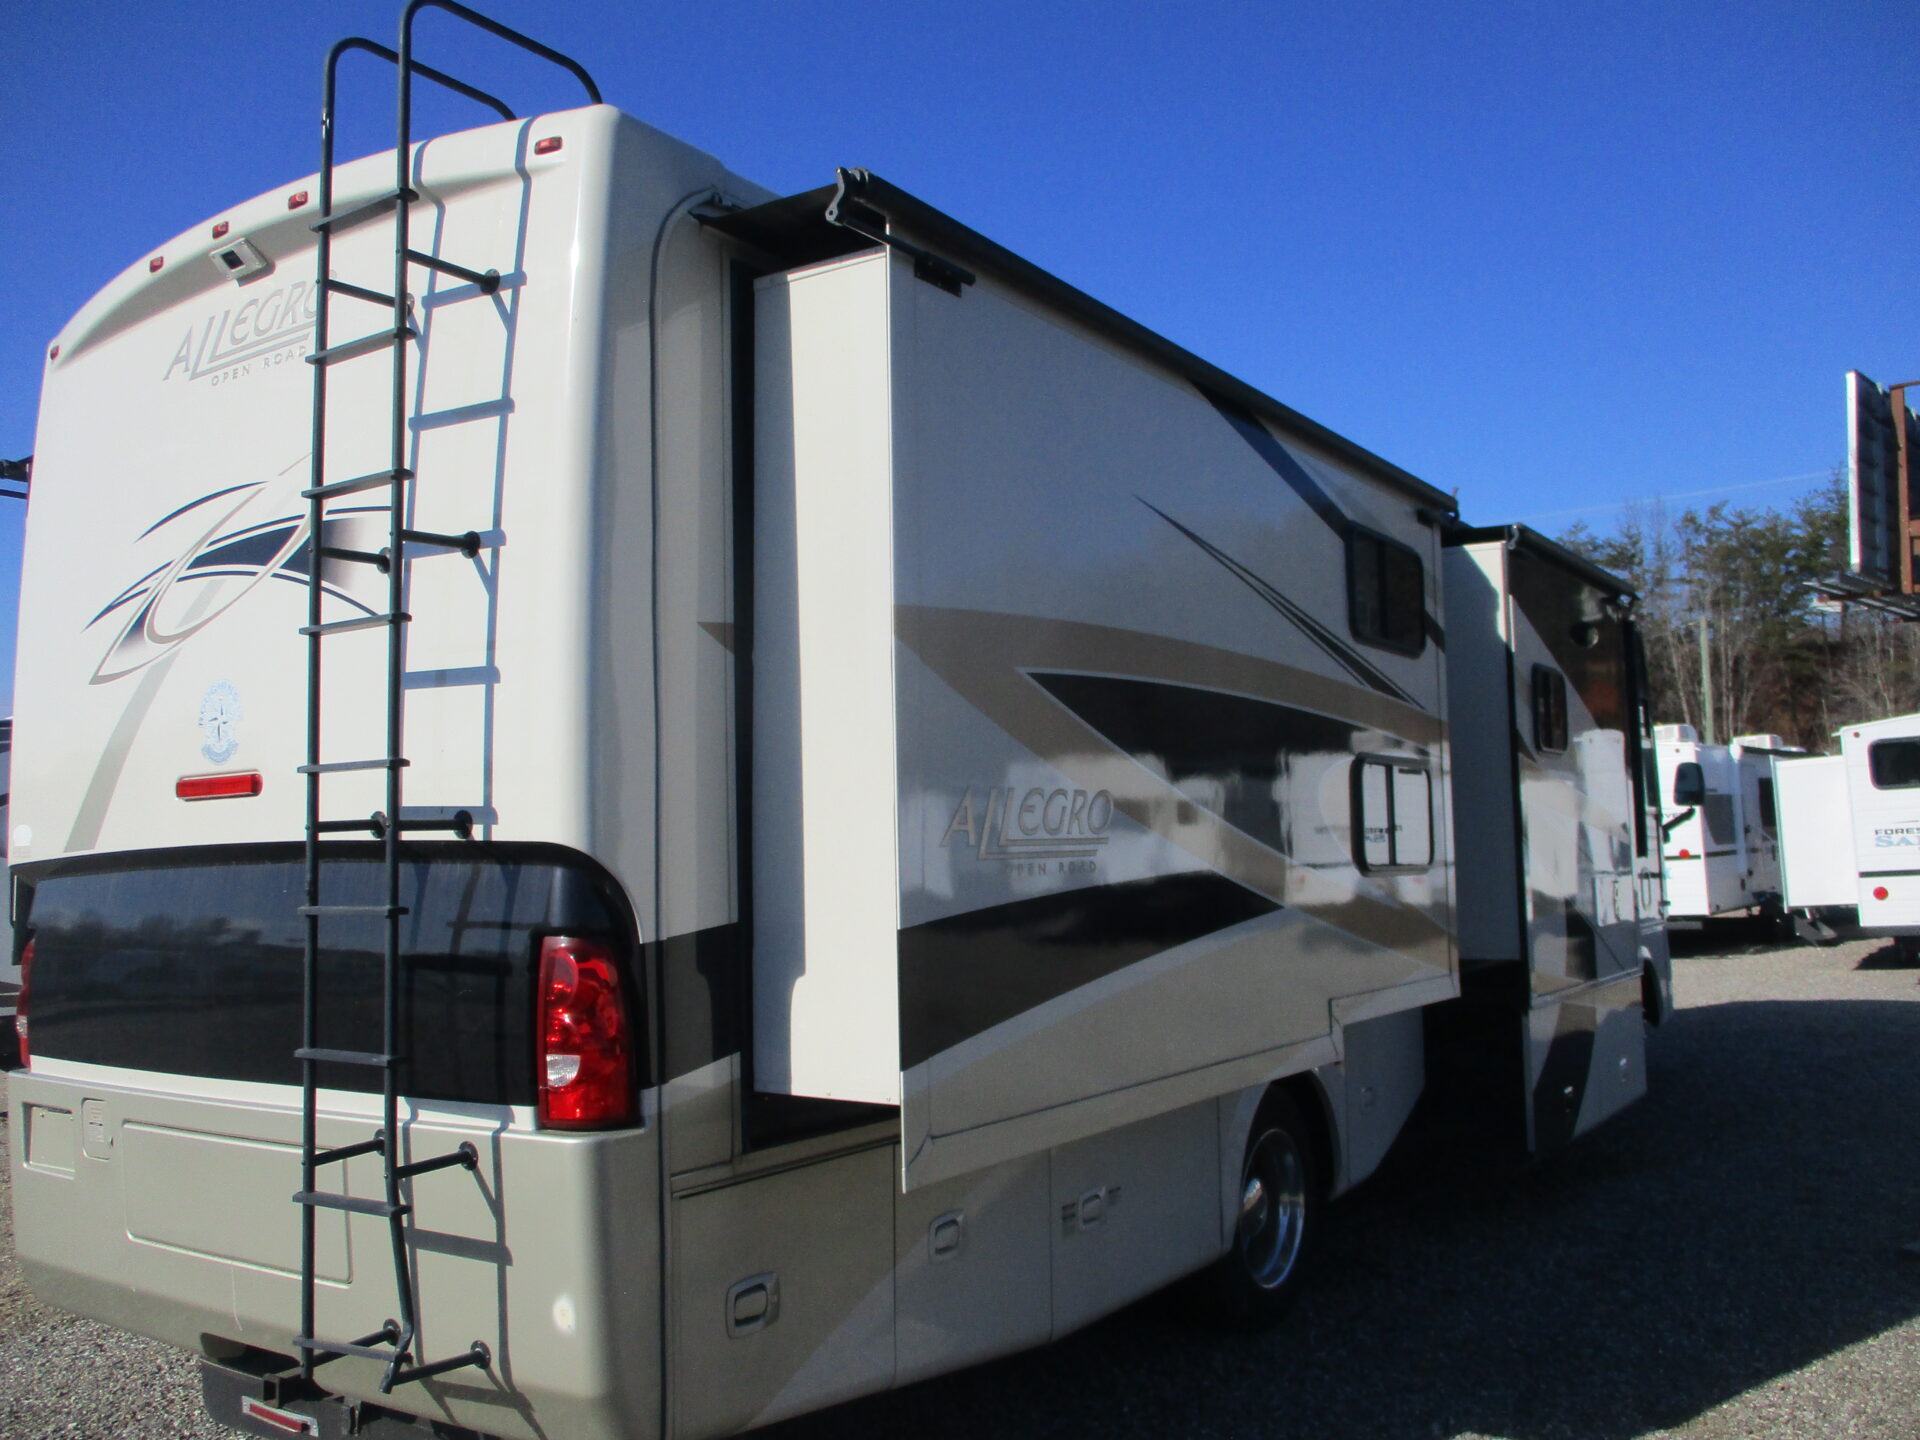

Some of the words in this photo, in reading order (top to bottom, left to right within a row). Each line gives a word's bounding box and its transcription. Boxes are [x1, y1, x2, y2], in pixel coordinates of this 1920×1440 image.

[211, 366, 250, 386] OPEN
[263, 345, 307, 369] ROAD
[939, 786, 1114, 861] ALLEGRO
[1004, 862, 1047, 876] OPEN
[1059, 861, 1097, 874] ROAD
